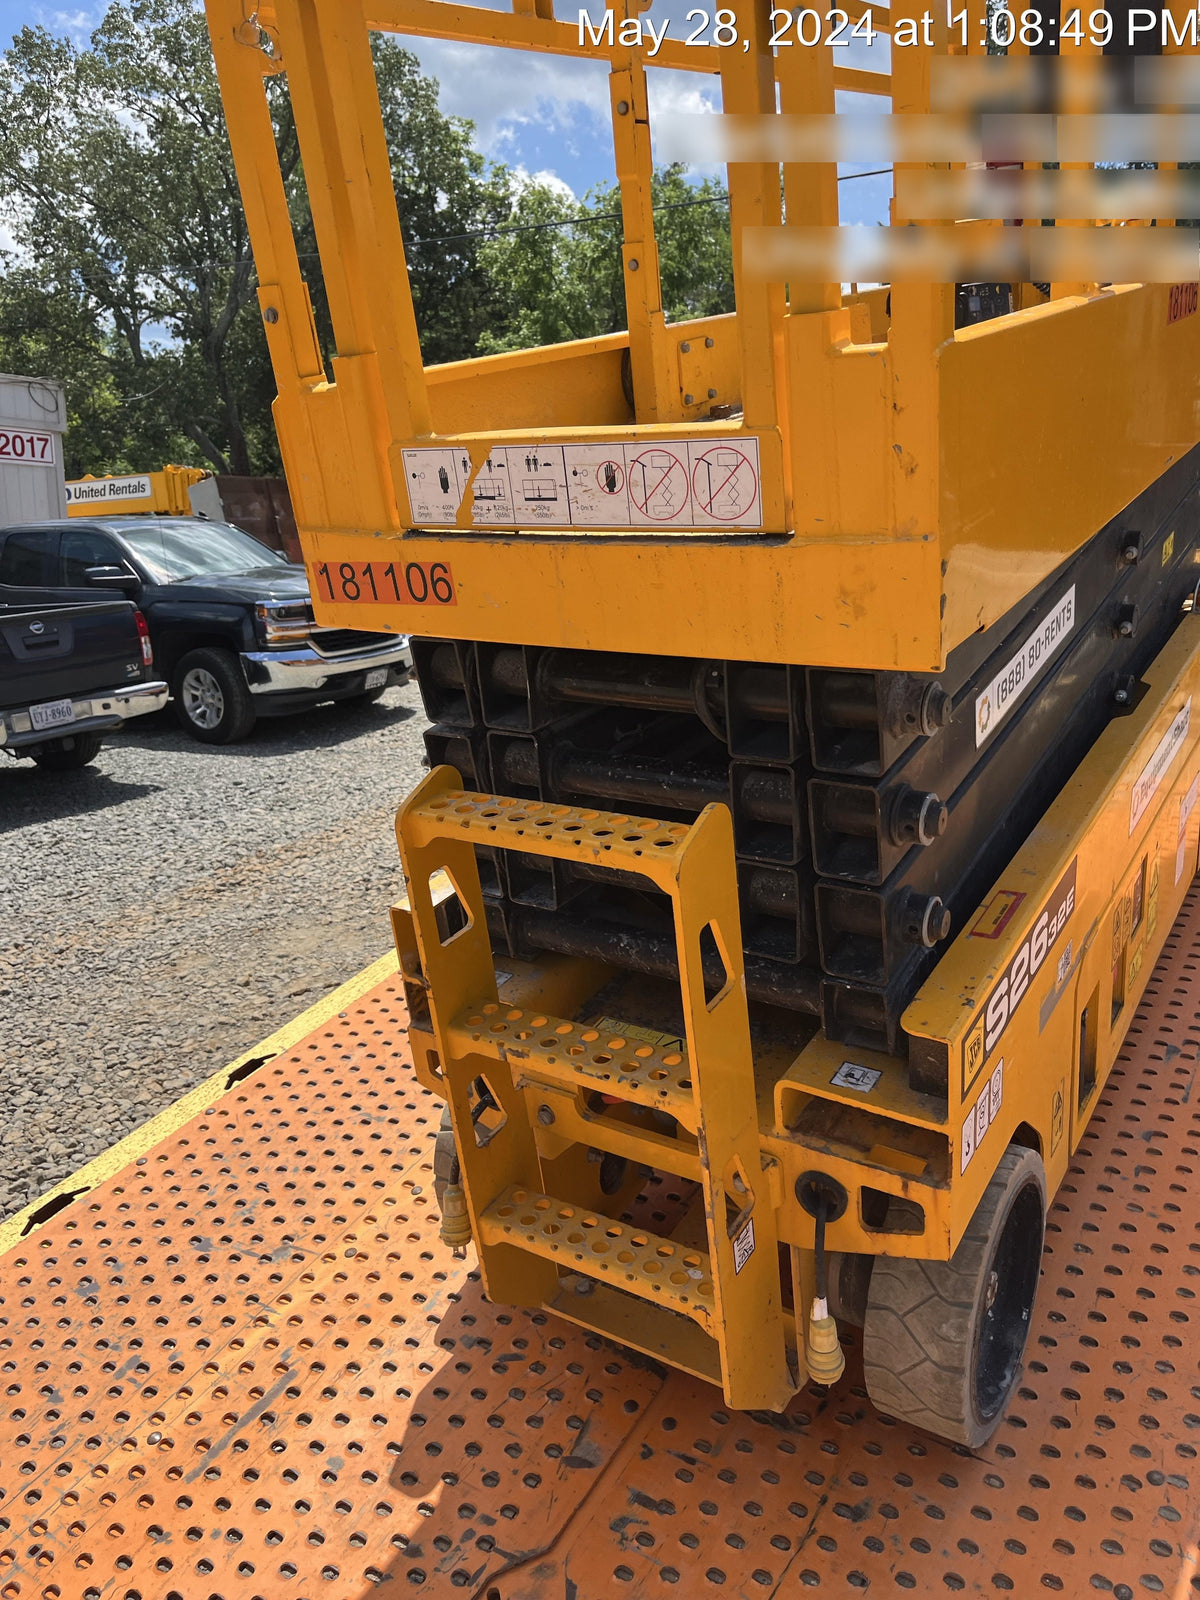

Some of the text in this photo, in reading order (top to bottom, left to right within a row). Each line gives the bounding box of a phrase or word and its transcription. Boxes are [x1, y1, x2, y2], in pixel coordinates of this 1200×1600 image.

[0, 432, 49, 459] 2017
[73, 480, 146, 500] United Rentals
[318, 562, 453, 603] 181106
[126, 663, 139, 672] SV
[996, 654, 1026, 711] (888)
